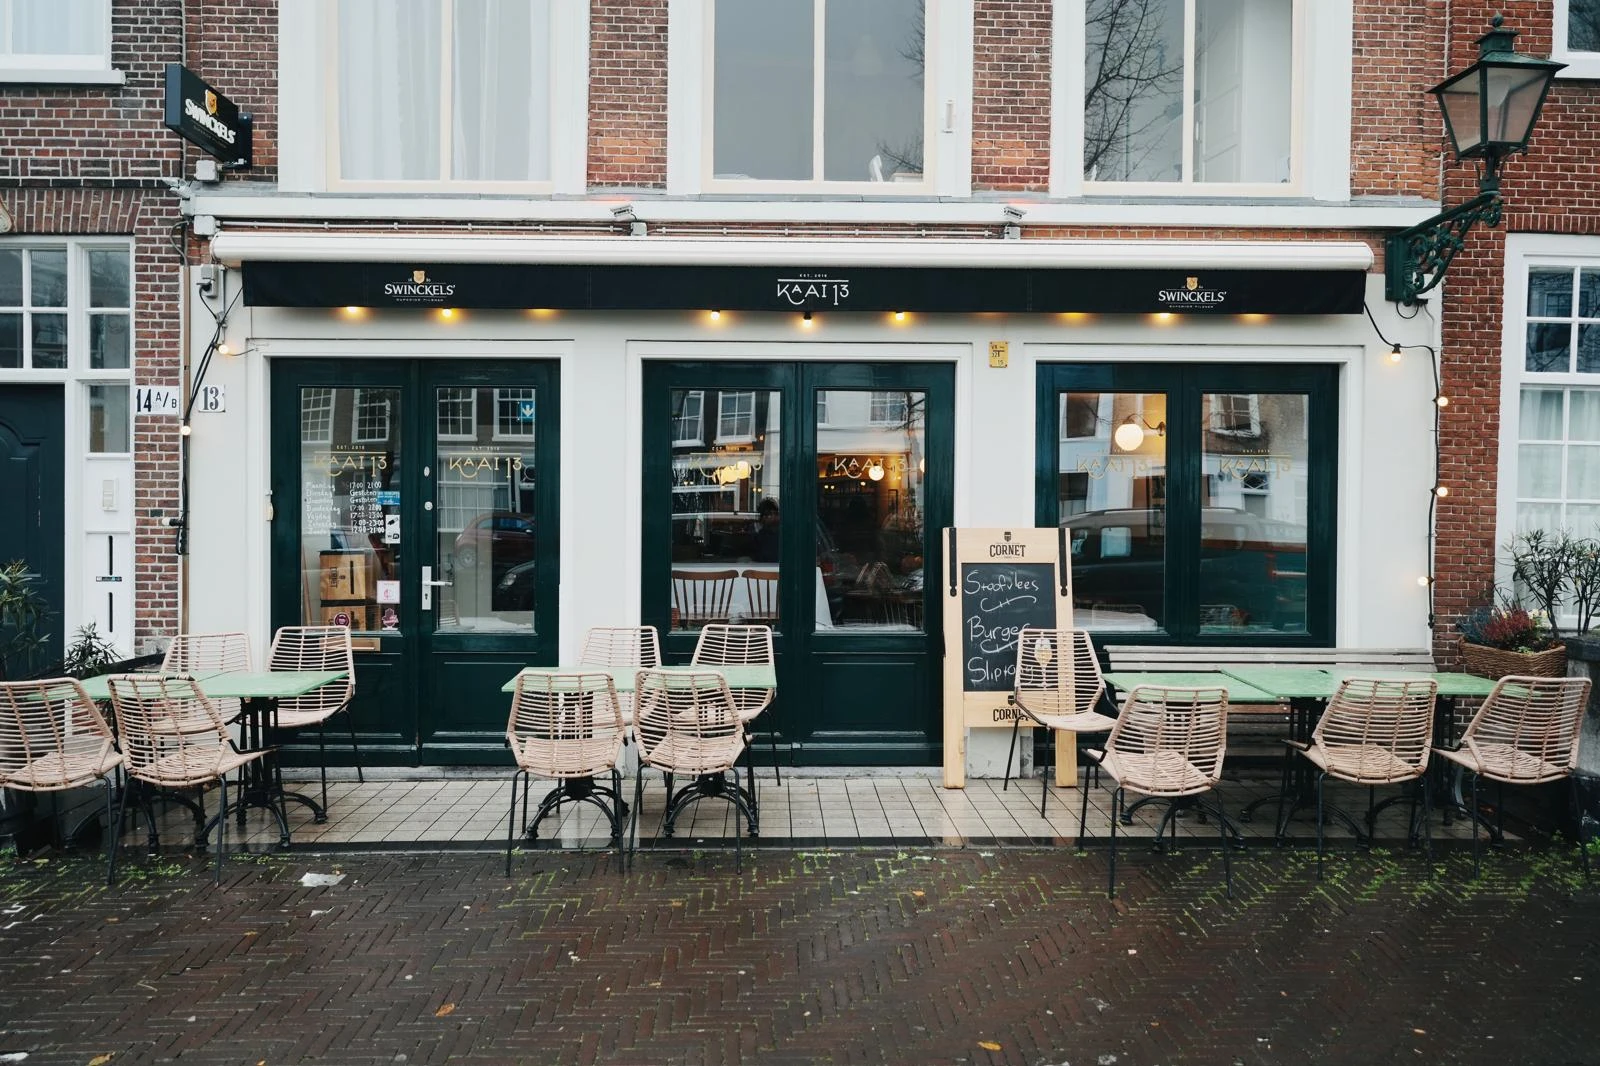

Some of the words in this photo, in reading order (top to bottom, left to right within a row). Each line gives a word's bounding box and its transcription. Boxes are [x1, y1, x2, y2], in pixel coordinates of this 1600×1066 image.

[384, 283, 456, 296] SWINCKELS'
[777, 283, 827, 305] KAAI
[832, 284, 850, 306] 13
[1158, 290, 1227, 303] SWINCKELS'
[203, 386, 219, 411] 13
[370, 455, 388, 478] 13
[449, 456, 500, 478] KAAI
[505, 456, 522, 478] 13
[1219, 458, 1270, 480] KAAI
[989, 544, 1026, 557] CORNET
[992, 708, 1029, 722] CORN
